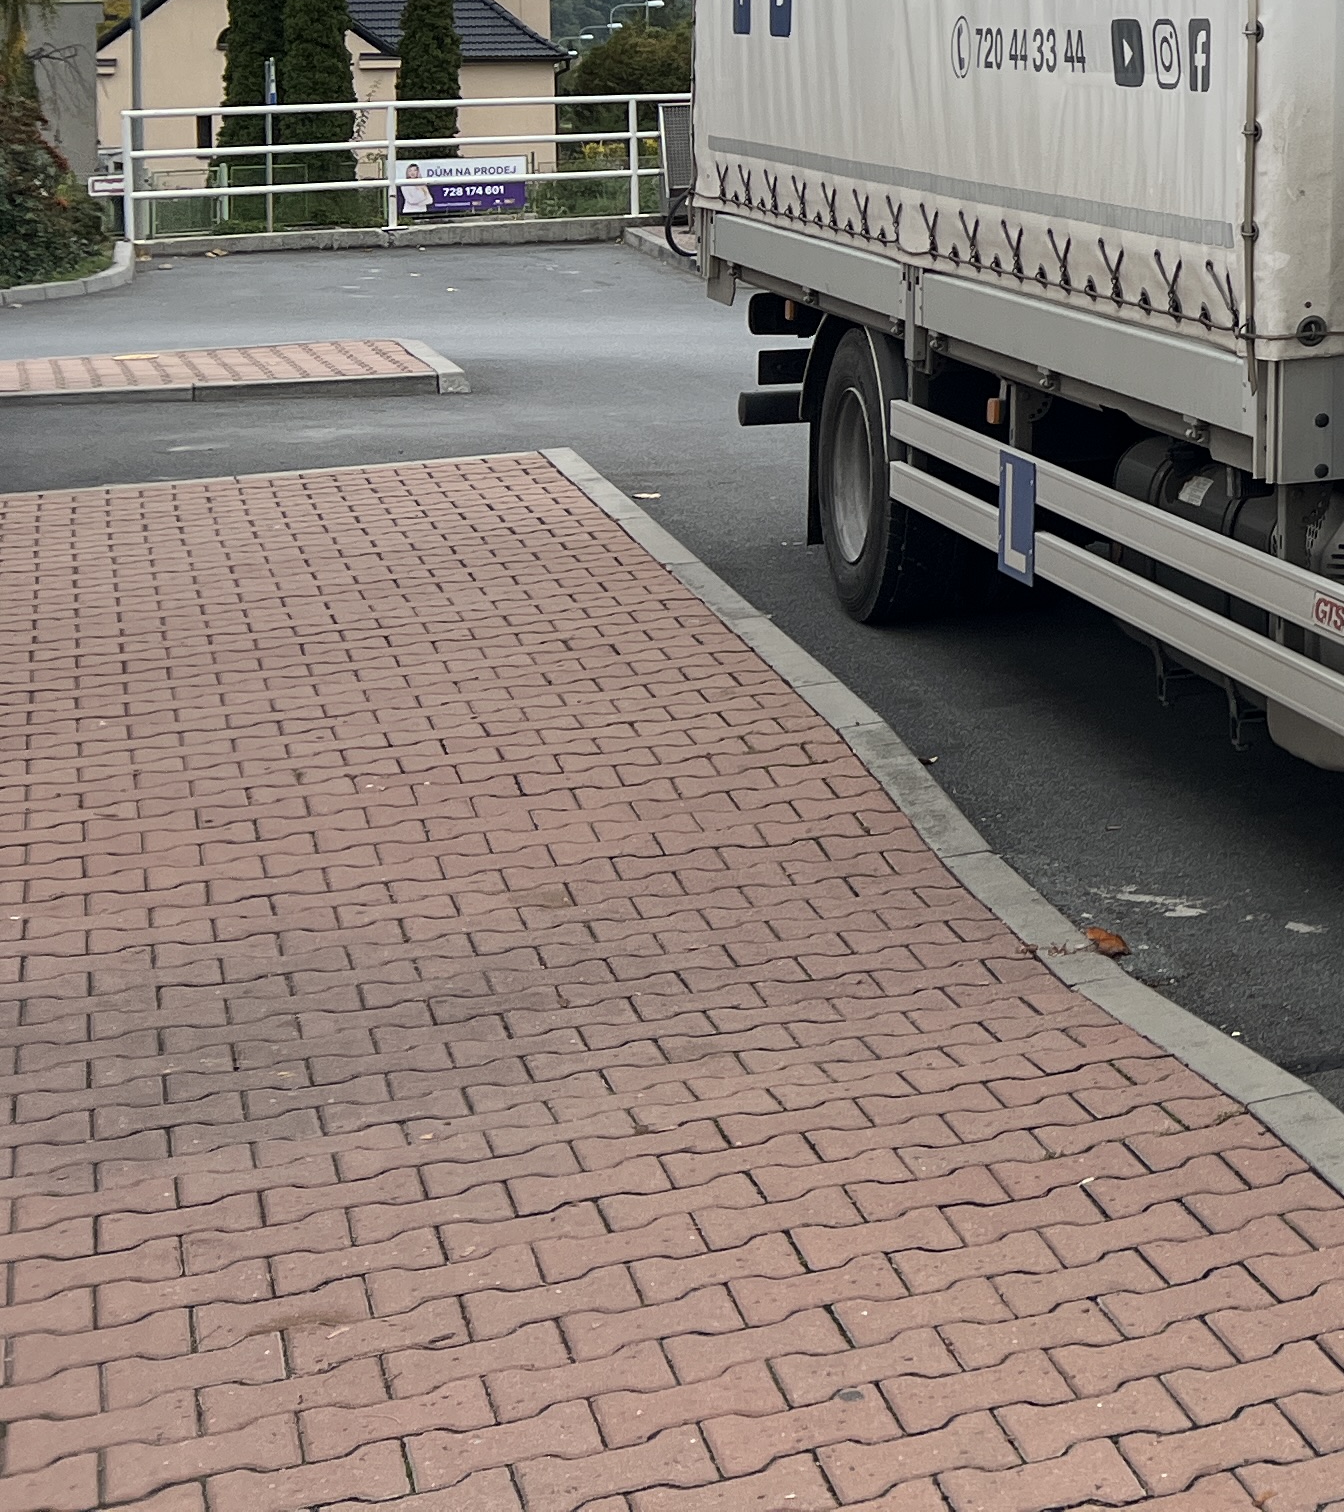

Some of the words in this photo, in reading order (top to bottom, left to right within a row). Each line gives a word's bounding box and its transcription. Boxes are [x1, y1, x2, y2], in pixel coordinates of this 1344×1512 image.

[975, 27, 1003, 71] 720
[1008, 28, 1028, 71] 44
[1032, 28, 1057, 73] 33
[1063, 29, 1086, 74] 44
[426, 166, 453, 178] DŮM
[455, 167, 471, 177] NA
[474, 165, 517, 176] PRODEJ
[442, 187, 463, 197] 728
[465, 186, 482, 196] 174
[485, 185, 504, 195] 601
[1004, 462, 1027, 574] L
